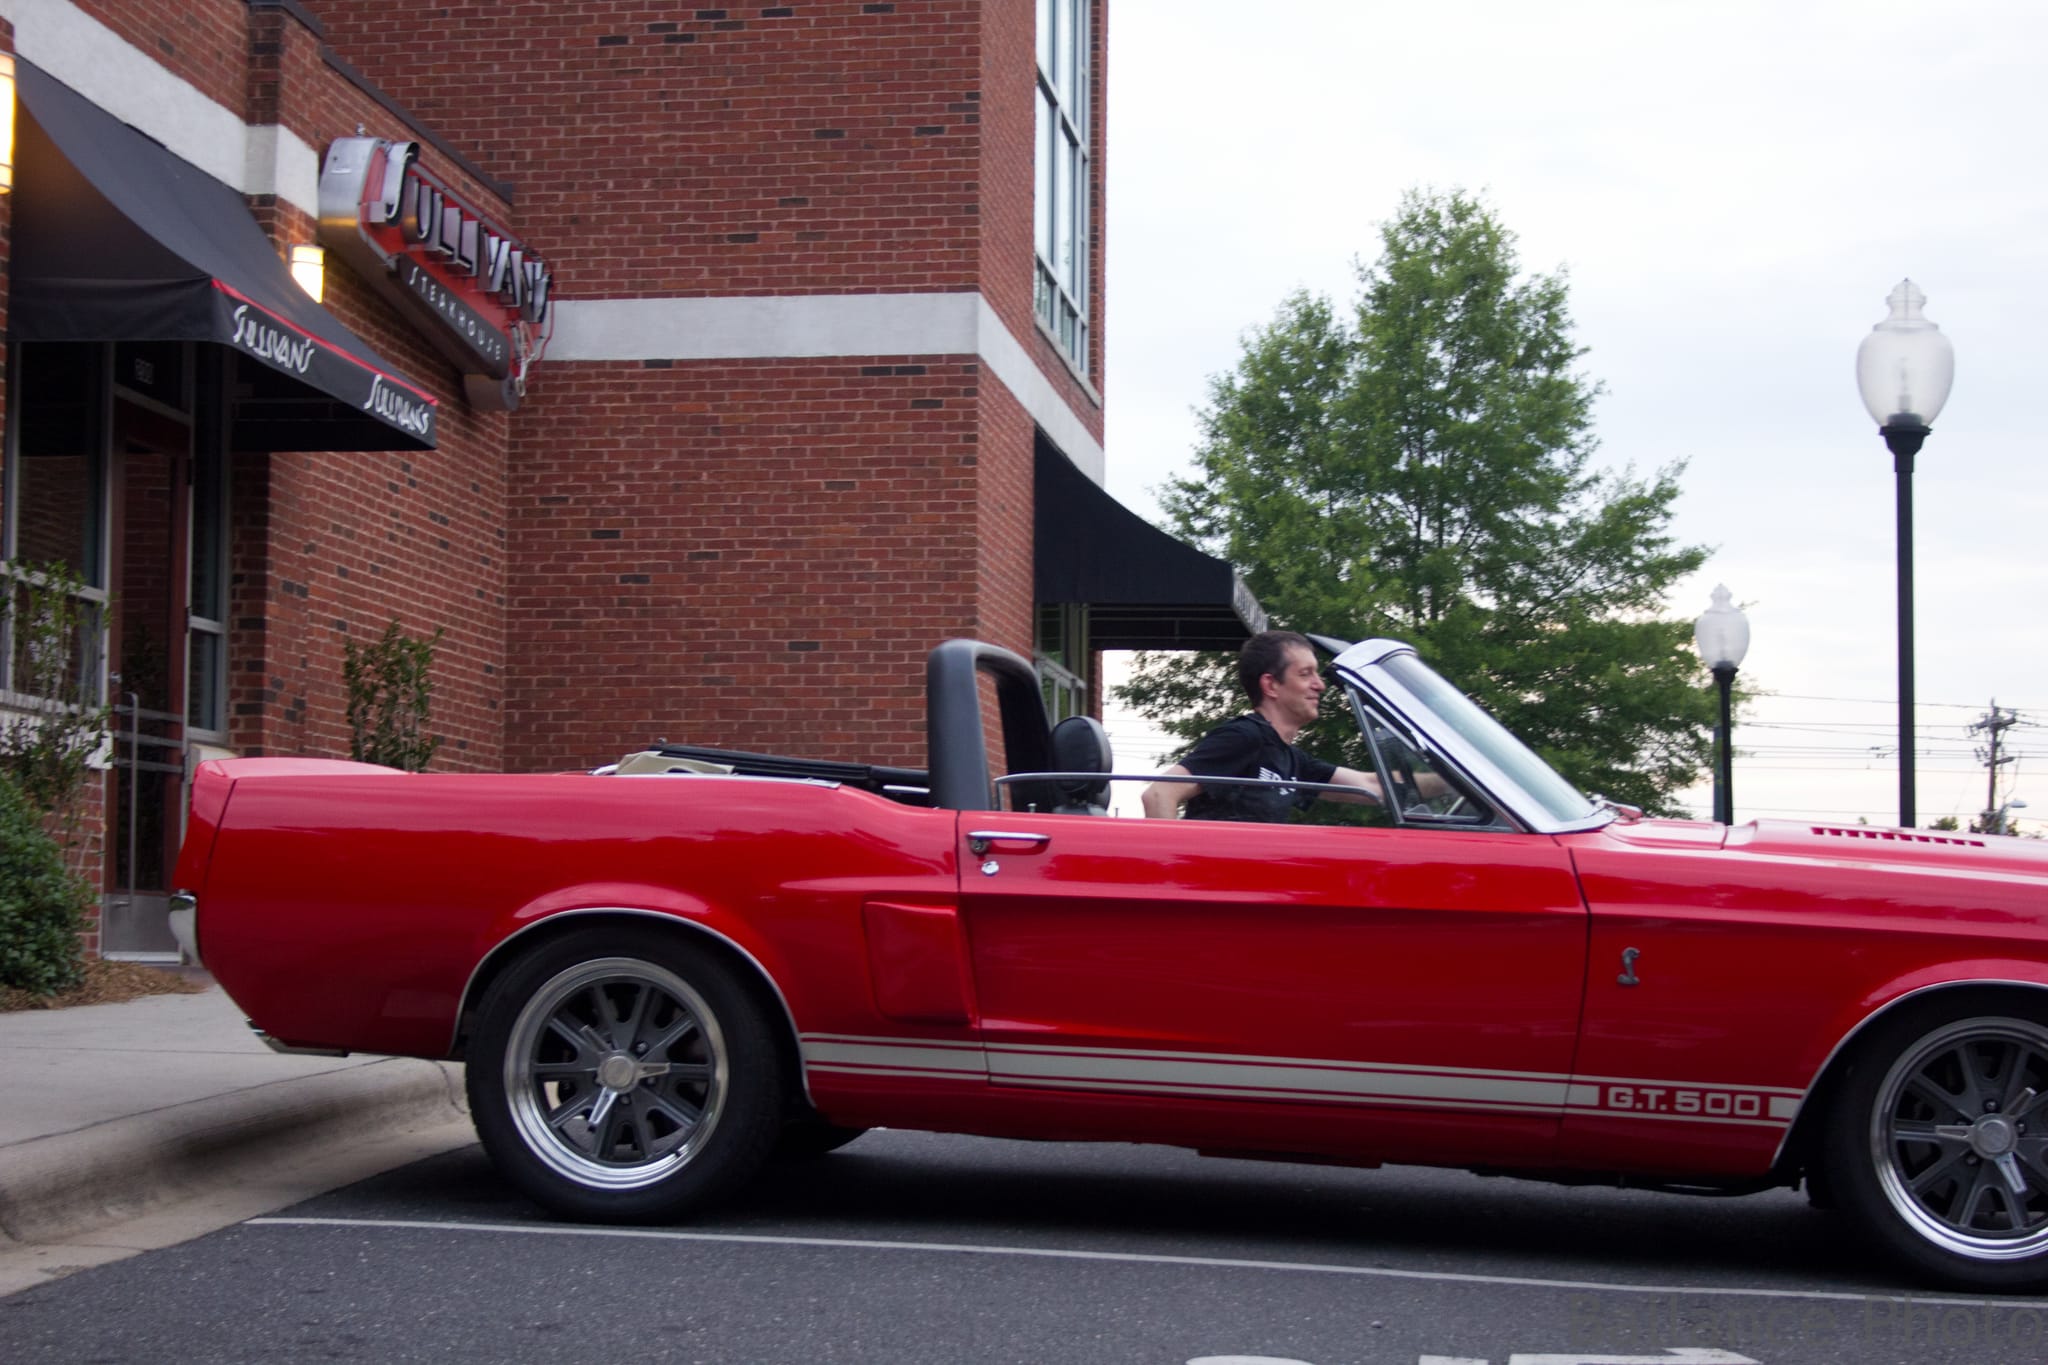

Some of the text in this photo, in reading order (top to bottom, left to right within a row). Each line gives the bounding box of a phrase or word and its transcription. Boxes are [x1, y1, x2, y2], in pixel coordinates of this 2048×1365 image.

[233, 305, 315, 374] SULLIVAN'S
[408, 266, 502, 361] STEAKHOUSE
[364, 374, 430, 434] SULLIVAN'S
[1607, 1087, 1760, 1116] G.T. 500
